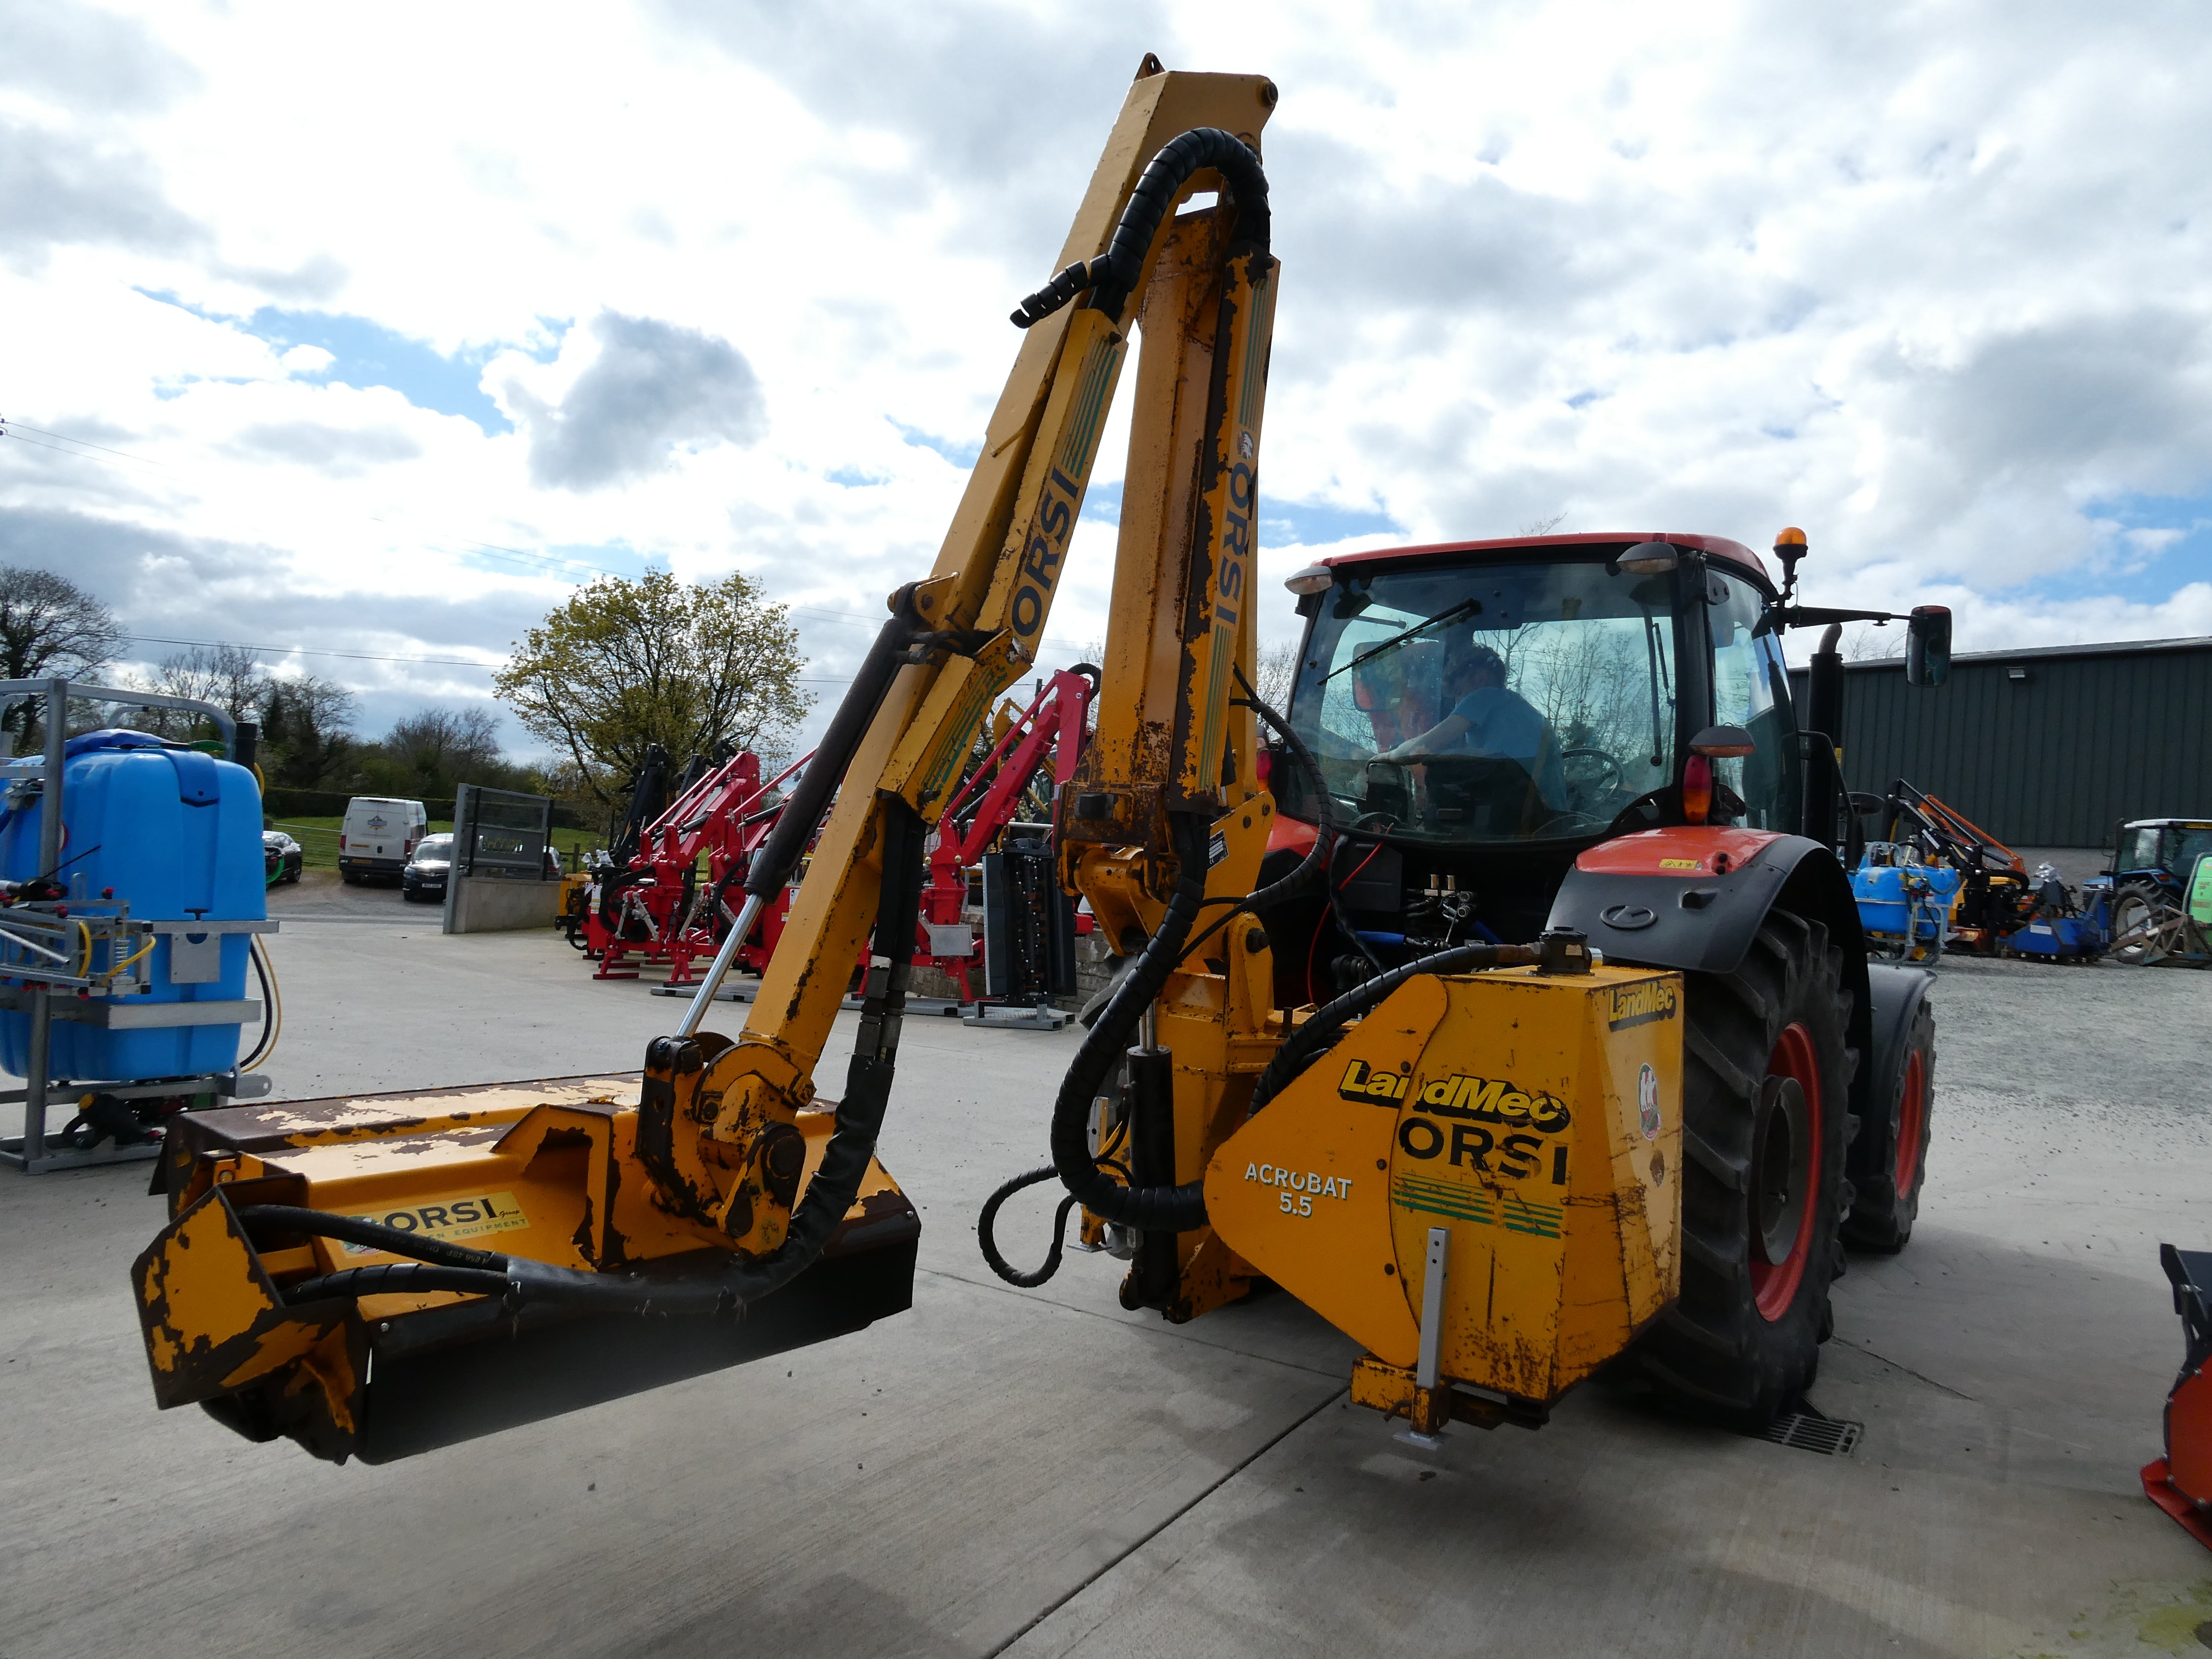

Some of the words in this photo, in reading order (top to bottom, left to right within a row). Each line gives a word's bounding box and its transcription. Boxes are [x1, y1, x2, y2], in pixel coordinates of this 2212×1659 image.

[1012, 464, 1080, 637] ORSI
[1217, 462, 1252, 626] ORSI
[1609, 981, 1675, 1025] LandMec
[1399, 1117, 1568, 1185] ORSI
[1245, 1161, 1353, 1200] ACROBAT
[384, 1198, 499, 1233] ORSI
[1279, 1192, 1312, 1217] 5.5
[454, 1219, 526, 1236] EQUIPMENT
